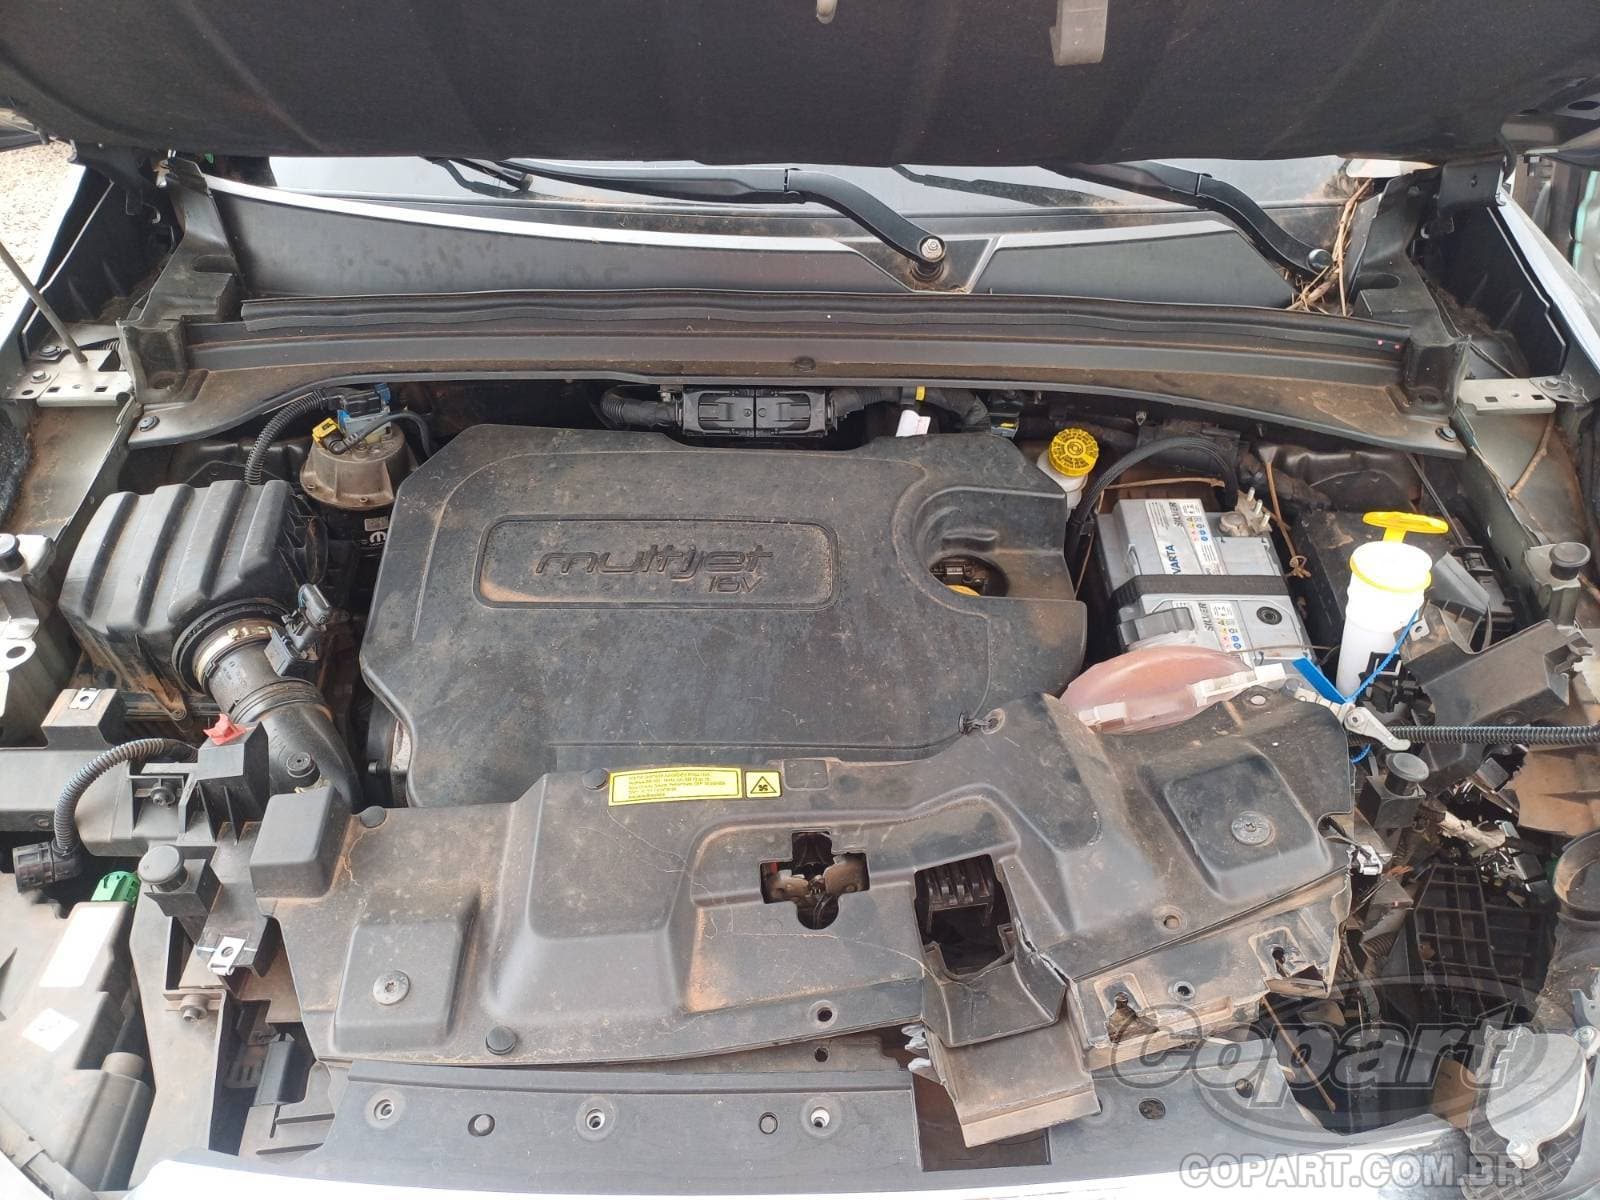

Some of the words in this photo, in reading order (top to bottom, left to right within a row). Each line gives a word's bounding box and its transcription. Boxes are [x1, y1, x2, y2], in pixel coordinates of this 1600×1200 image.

[1166, 544, 1181, 575] VARTA
[708, 575, 763, 594] 16V
[1198, 602, 1215, 632] SILVER
